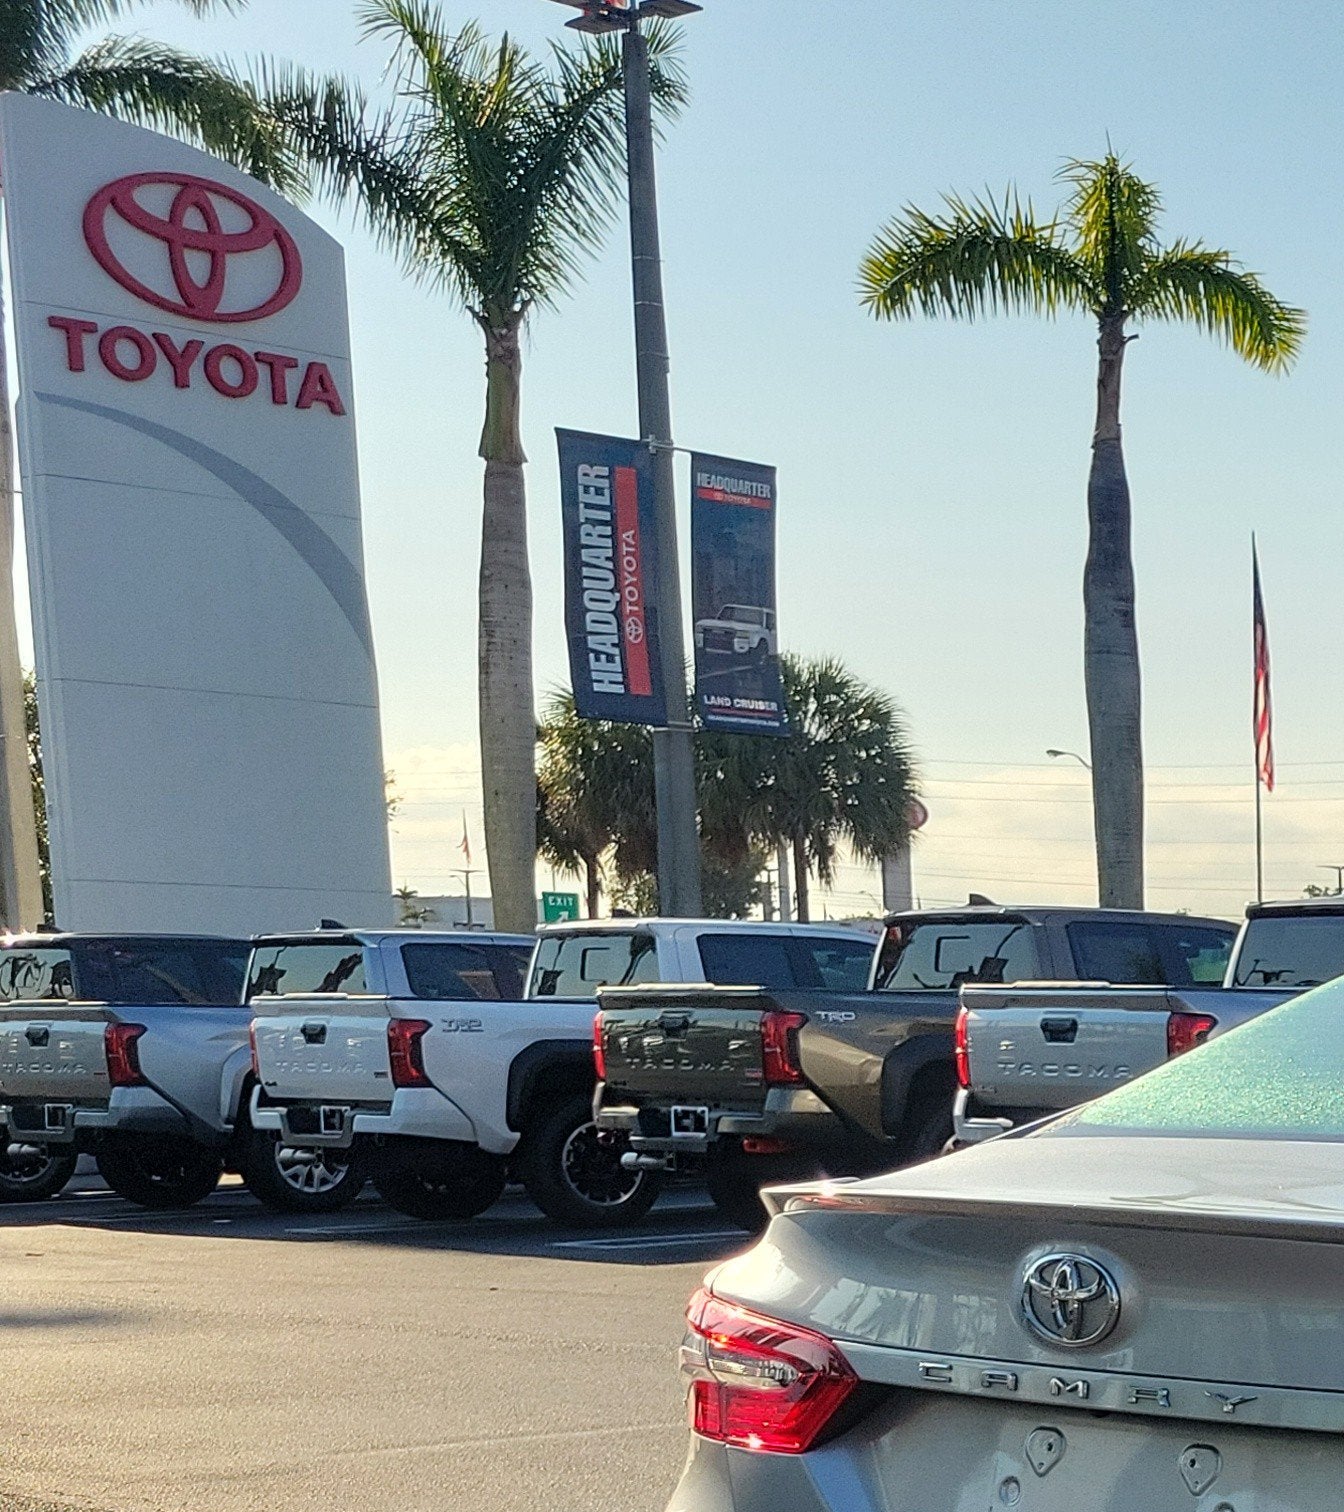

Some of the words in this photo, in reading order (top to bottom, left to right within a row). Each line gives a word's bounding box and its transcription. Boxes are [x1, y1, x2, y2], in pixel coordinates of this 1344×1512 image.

[47, 315, 346, 416] TOYOTA
[697, 472, 771, 498] HEADQUARTER
[577, 463, 626, 694] HEADQUARTER
[622, 530, 640, 615] TOYOTA
[704, 694, 732, 707] LAND
[548, 895, 574, 907] EXIT
[815, 1010, 856, 1022] TRD
[625, 1058, 735, 1071] TACOMA
[998, 1061, 1134, 1079] TACOMA
[918, 1361, 1258, 1413] CAMRY
